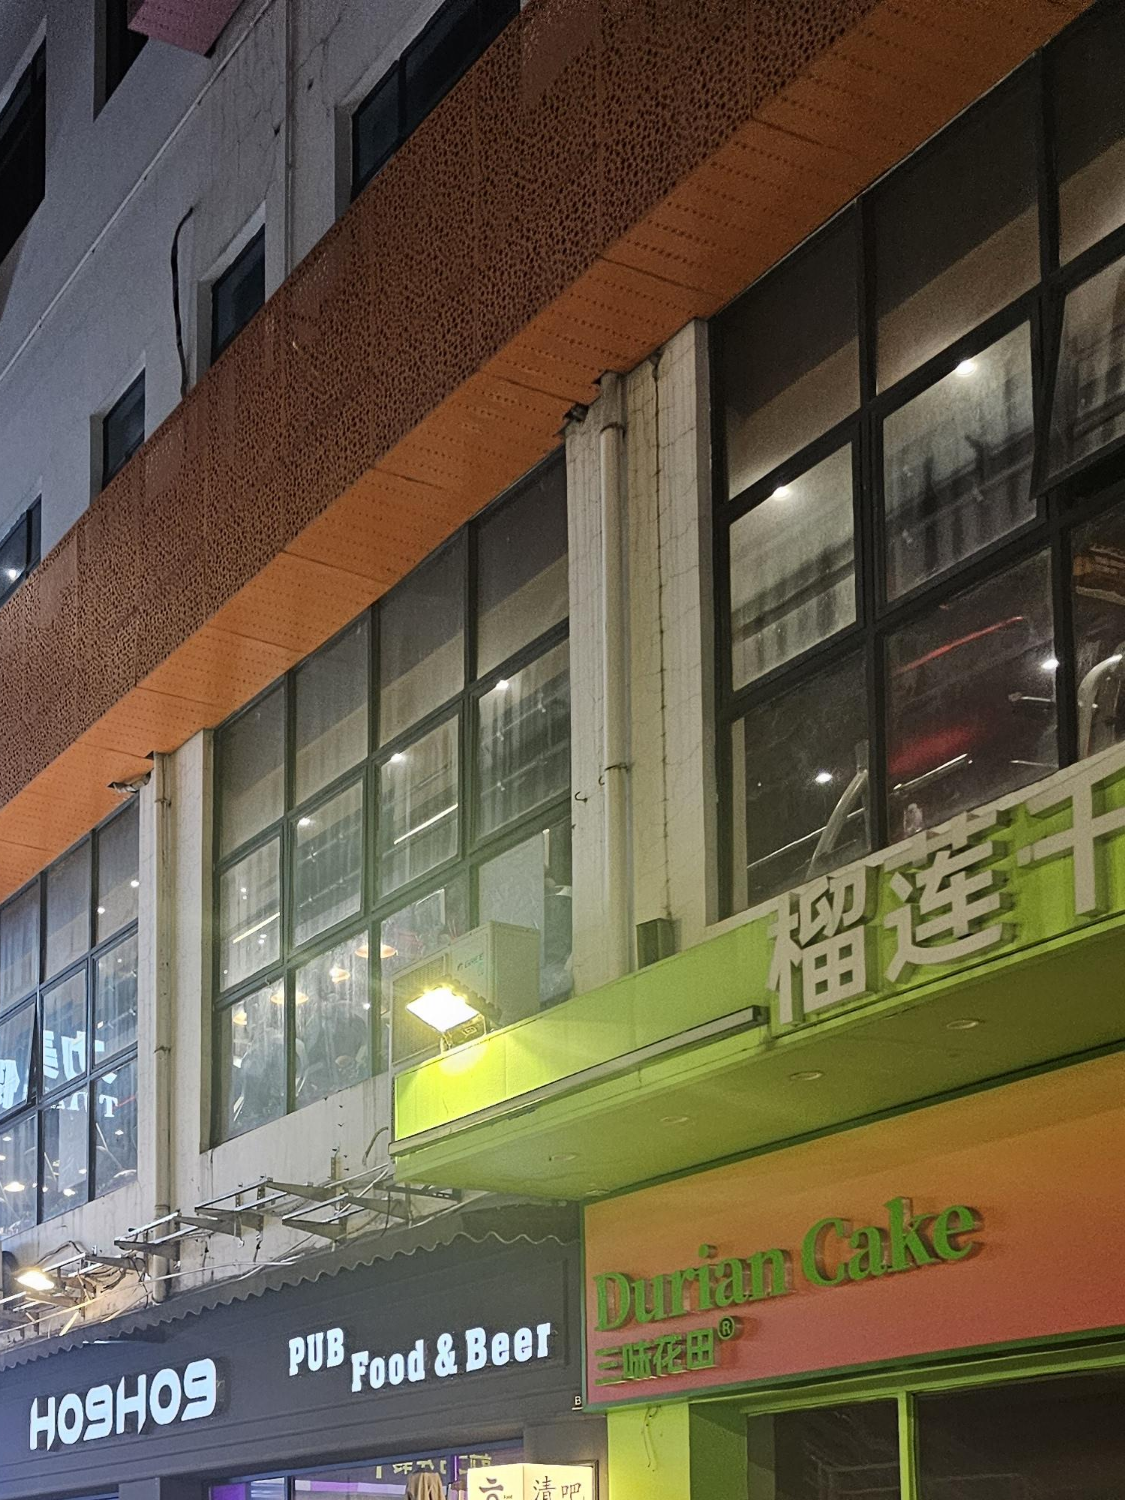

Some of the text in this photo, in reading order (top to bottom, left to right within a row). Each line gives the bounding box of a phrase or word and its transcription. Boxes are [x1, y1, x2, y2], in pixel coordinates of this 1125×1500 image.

[593, 1196, 978, 1332] Durian Cake
[288, 1322, 551, 1392] PUB Food & Beer
